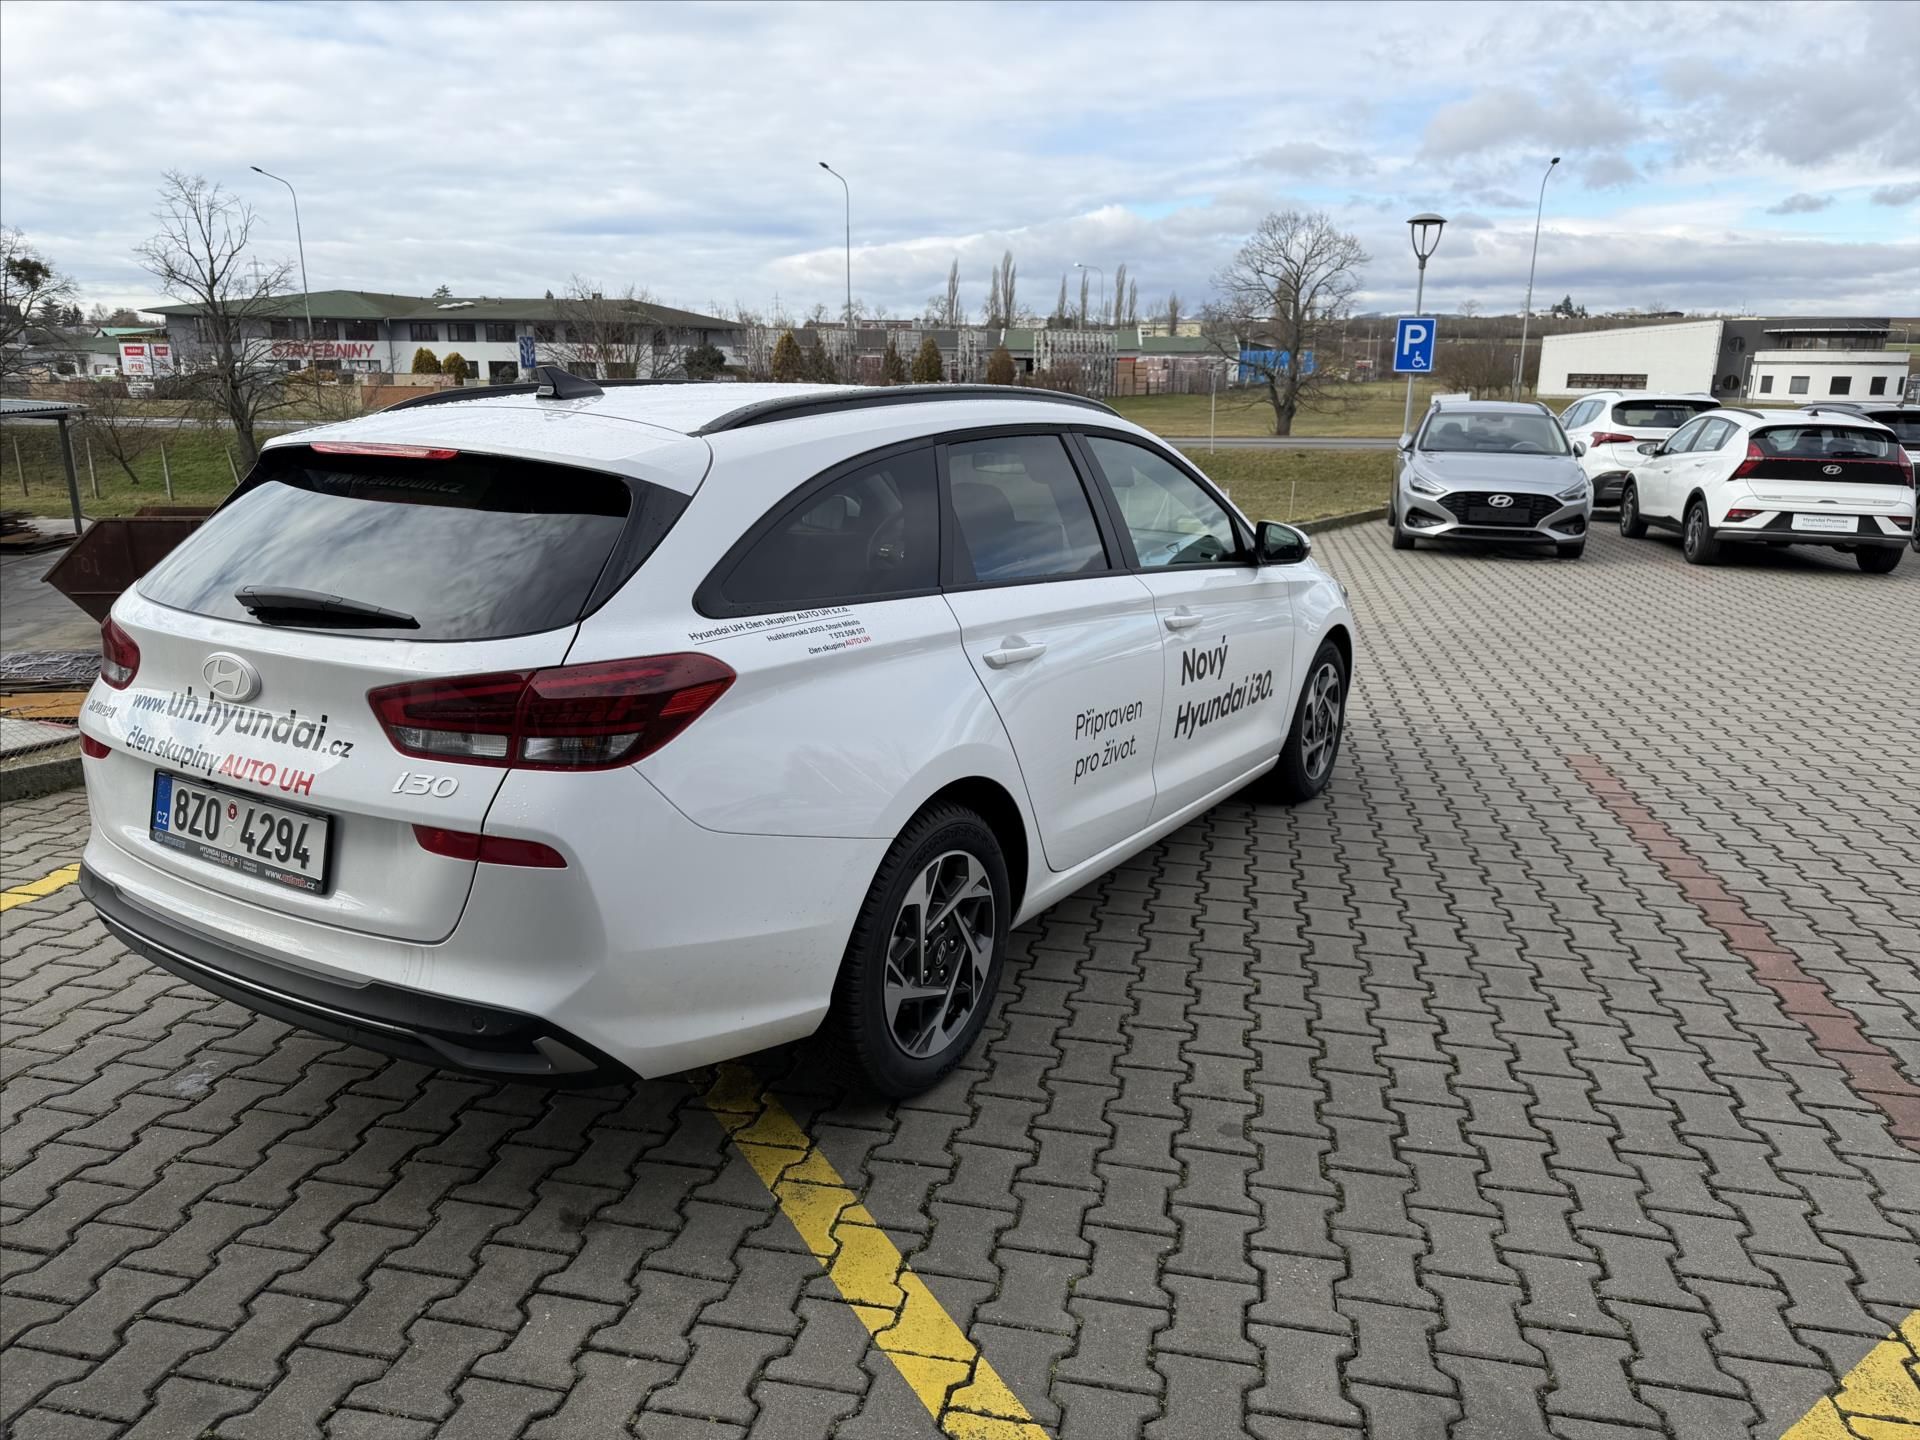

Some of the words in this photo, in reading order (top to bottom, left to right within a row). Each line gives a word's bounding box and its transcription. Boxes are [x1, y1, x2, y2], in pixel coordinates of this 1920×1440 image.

[271, 343, 374, 358] STAVEBNINY
[1402, 324, 1427, 355] P
[688, 624, 731, 641] Hyundai
[729, 622, 745, 634] UH
[745, 618, 764, 630] člen
[764, 613, 797, 627] skupiny
[797, 609, 819, 620] AUTO
[819, 607, 833, 617] UH
[808, 645, 823, 655] člen
[822, 641, 846, 653] skupiny
[845, 637, 862, 647] AUTO
[861, 635, 871, 643] UH
[1181, 635, 1228, 686] Nový
[132, 686, 354, 758] www.uh.hyundai.cz
[1075, 700, 1143, 740] Připraven
[1174, 675, 1249, 739] Hyundai
[1246, 669, 1273, 707] i30.
[126, 725, 156, 753] člen
[155, 737, 221, 776] skupiny
[218, 753, 277, 786] AUTO
[279, 767, 315, 796] UH
[1074, 752, 1099, 785] pro
[1101, 735, 1137, 768] život.
[392, 771, 460, 798] i30
[156, 810, 169, 825] CZ
[240, 807, 311, 870] 4294
